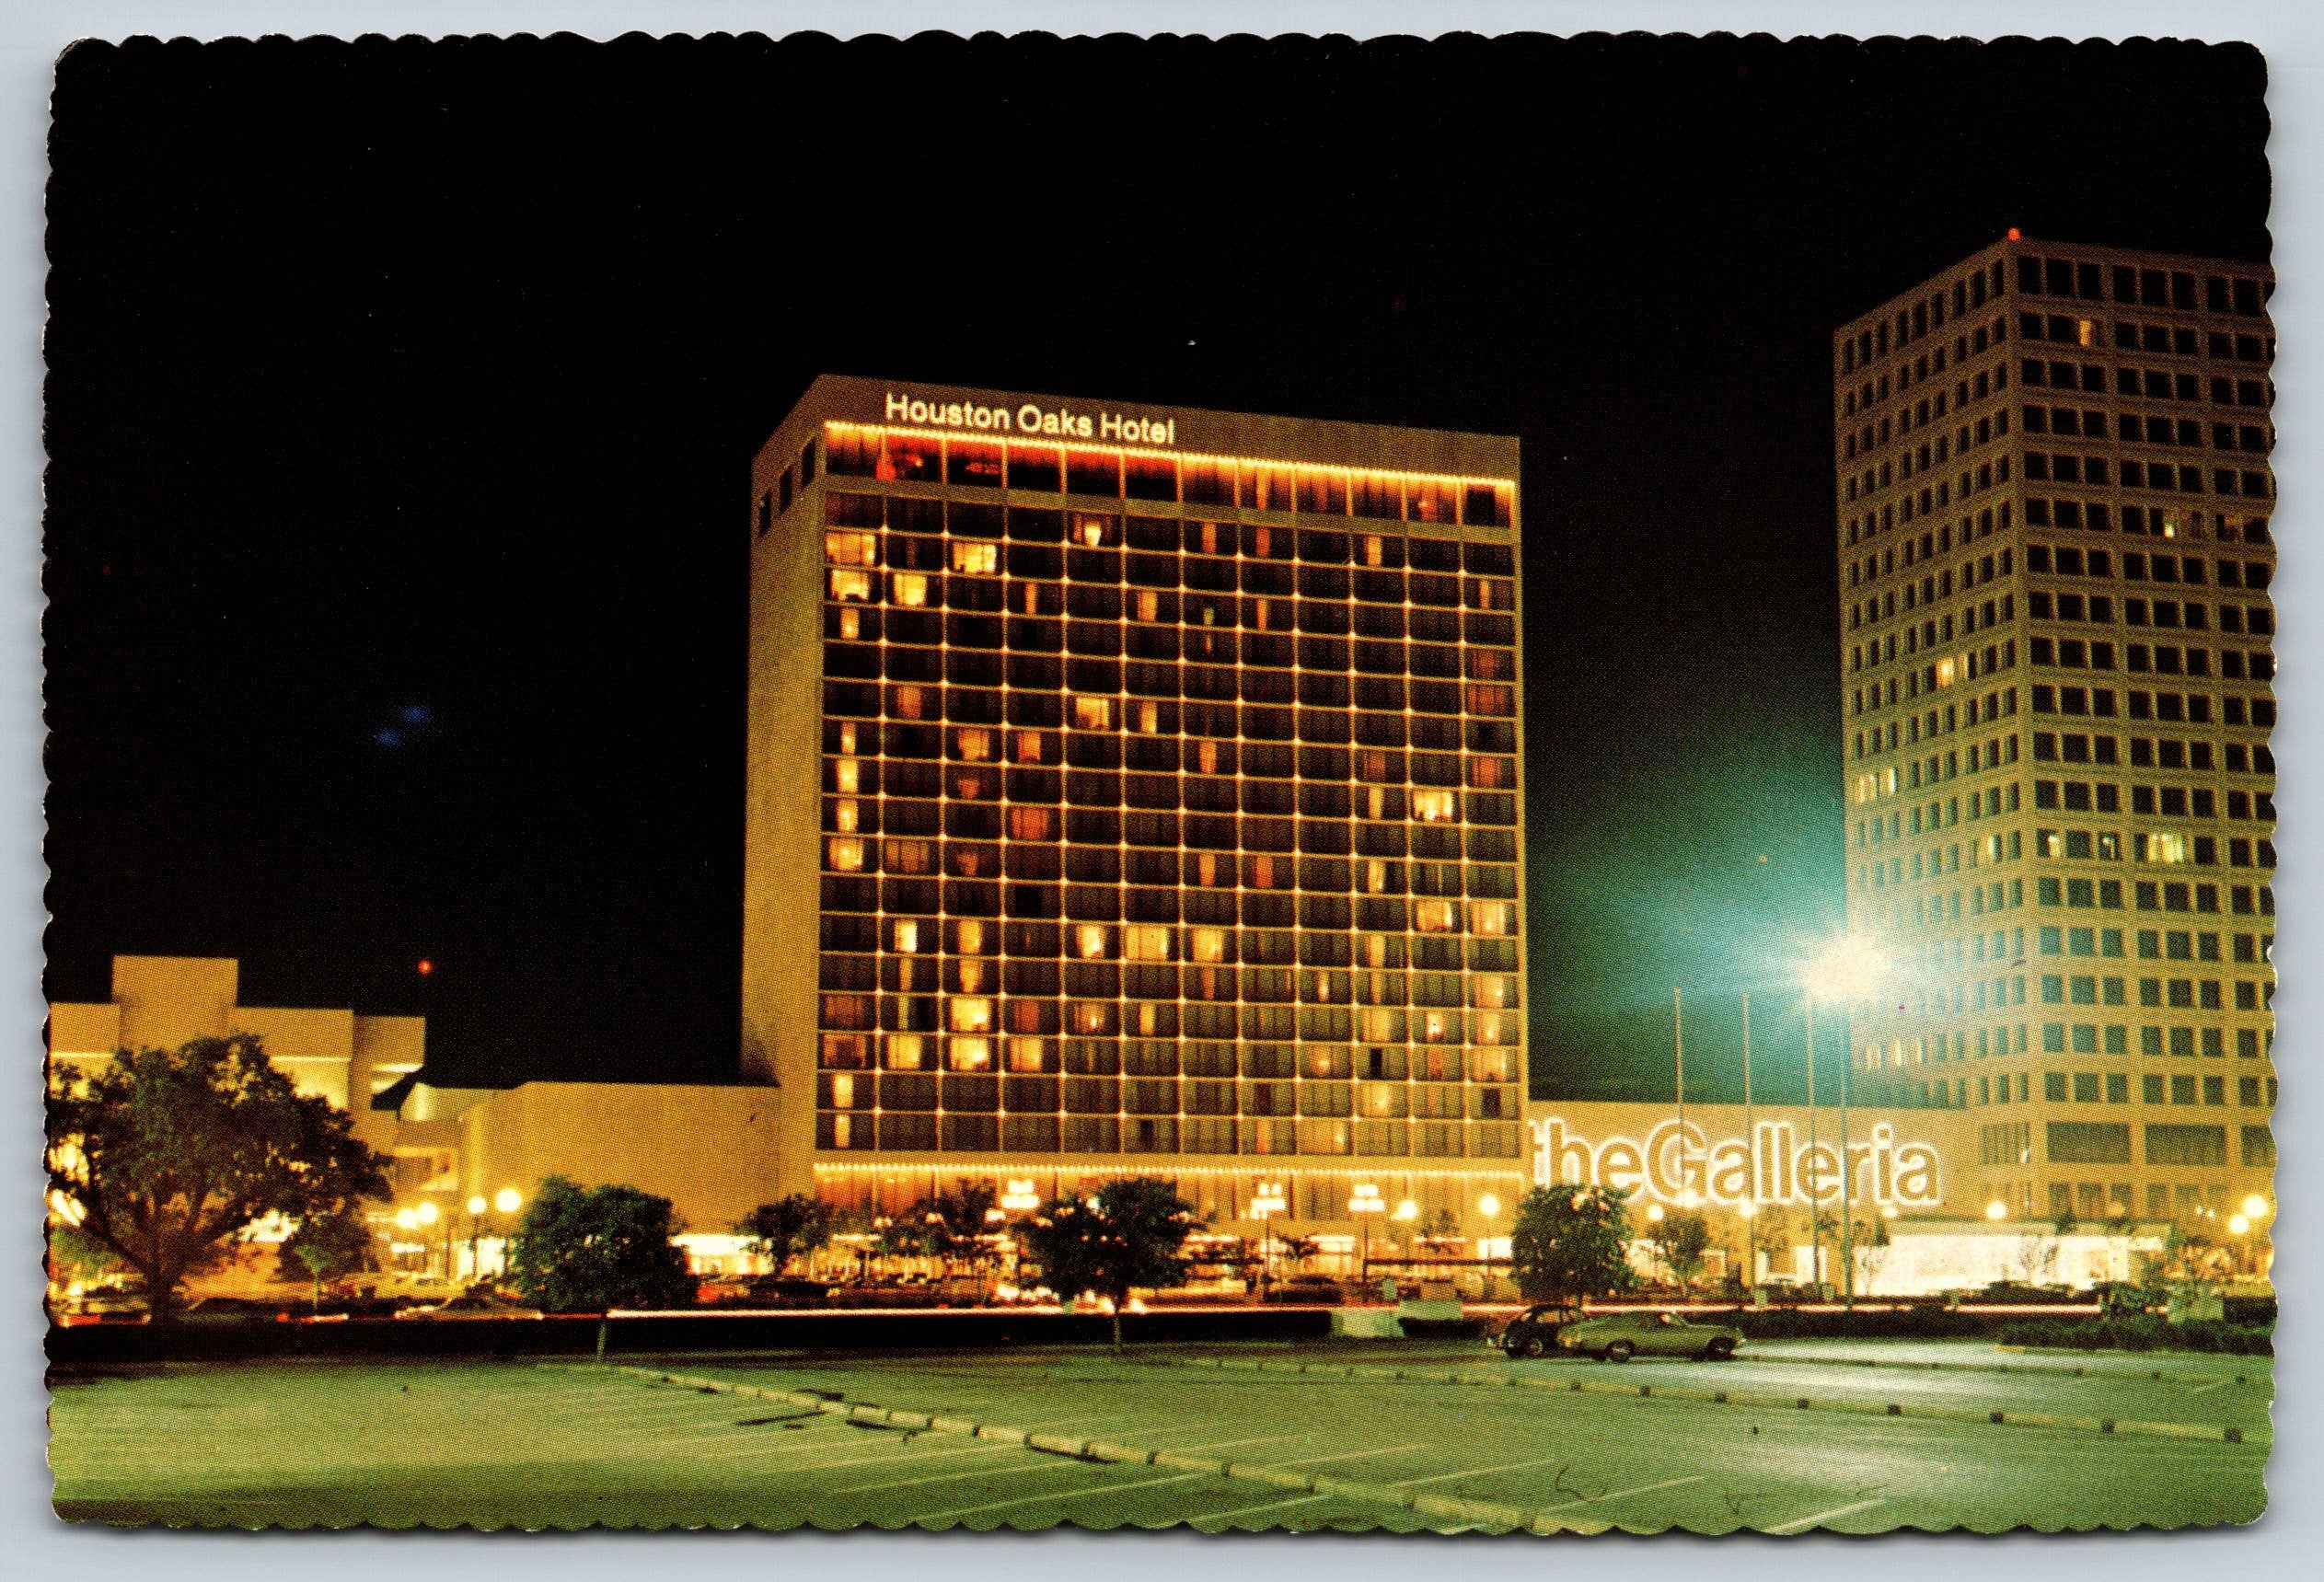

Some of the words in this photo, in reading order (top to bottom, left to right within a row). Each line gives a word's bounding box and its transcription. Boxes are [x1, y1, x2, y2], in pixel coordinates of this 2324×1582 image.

[885, 392, 1011, 429] Houston
[1017, 404, 1093, 437] Oaks
[1100, 413, 1175, 445] Hotel
